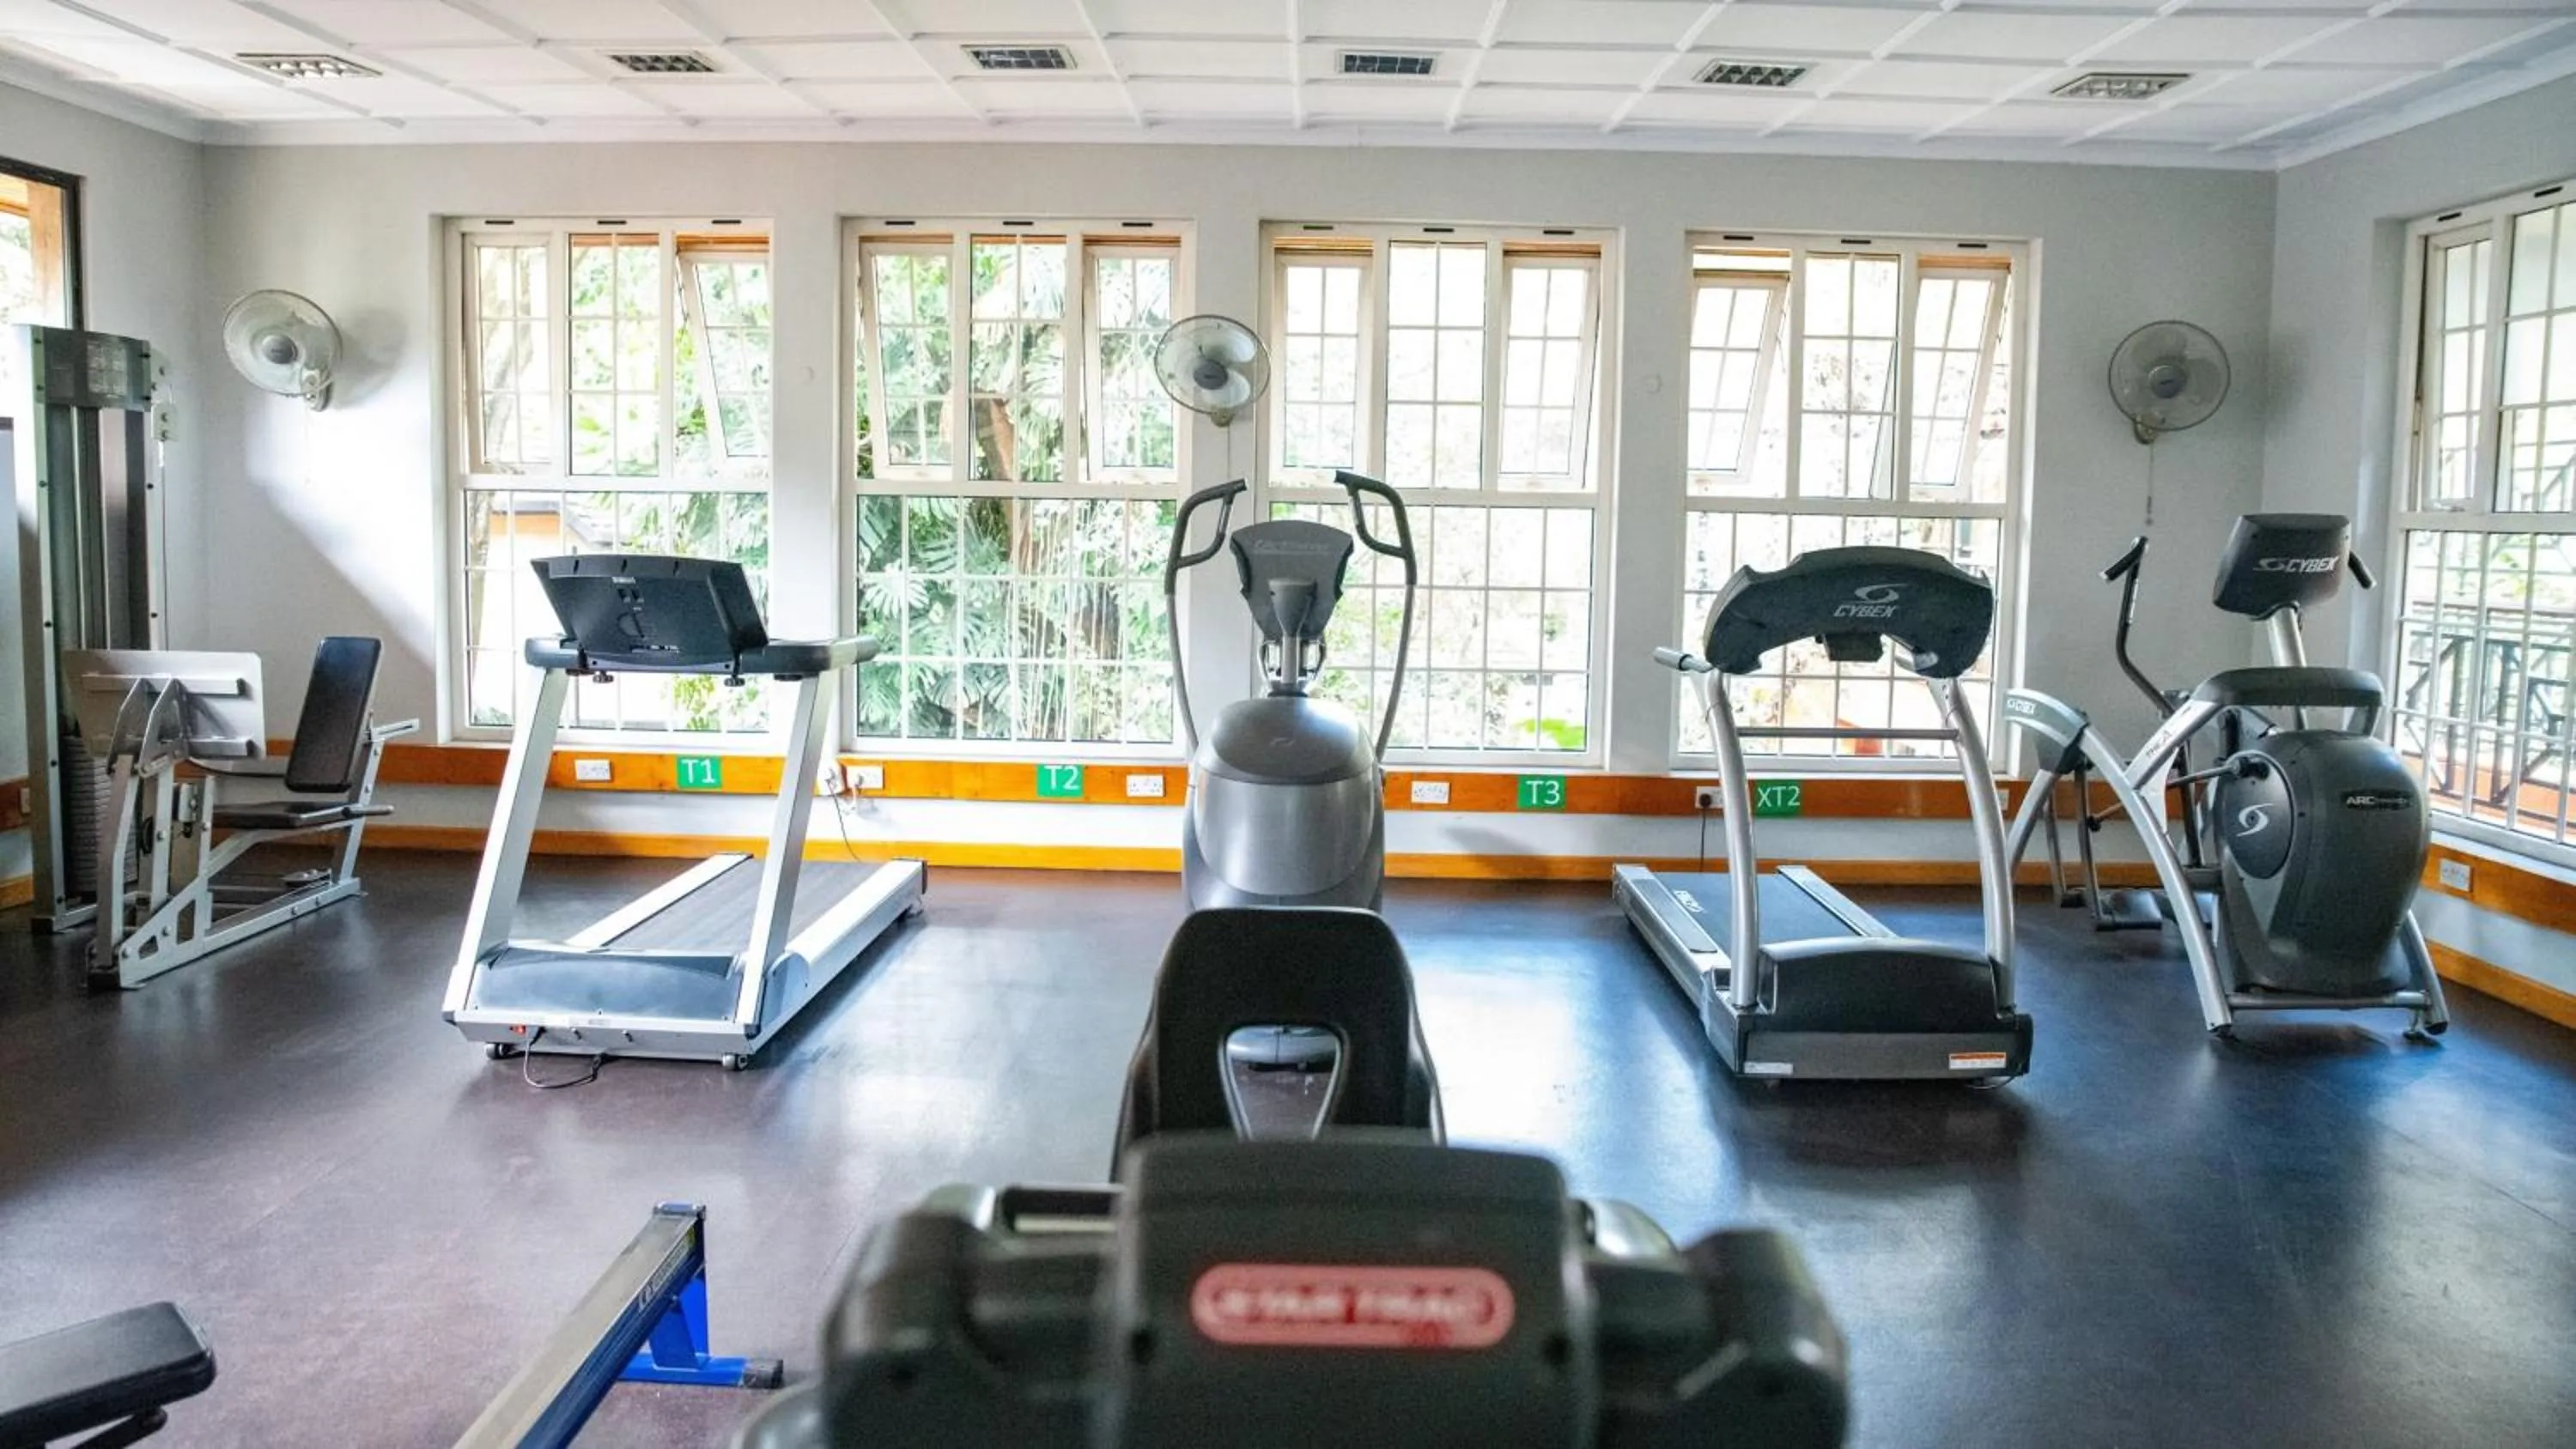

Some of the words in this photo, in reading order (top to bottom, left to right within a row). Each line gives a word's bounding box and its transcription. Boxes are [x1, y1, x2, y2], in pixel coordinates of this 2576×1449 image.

[681, 759, 715, 784] T1
[1044, 765, 1079, 790] T2
[1525, 780, 1560, 804] T3
[1758, 785, 1801, 807] XT2
[2346, 796, 2375, 804] ARC
